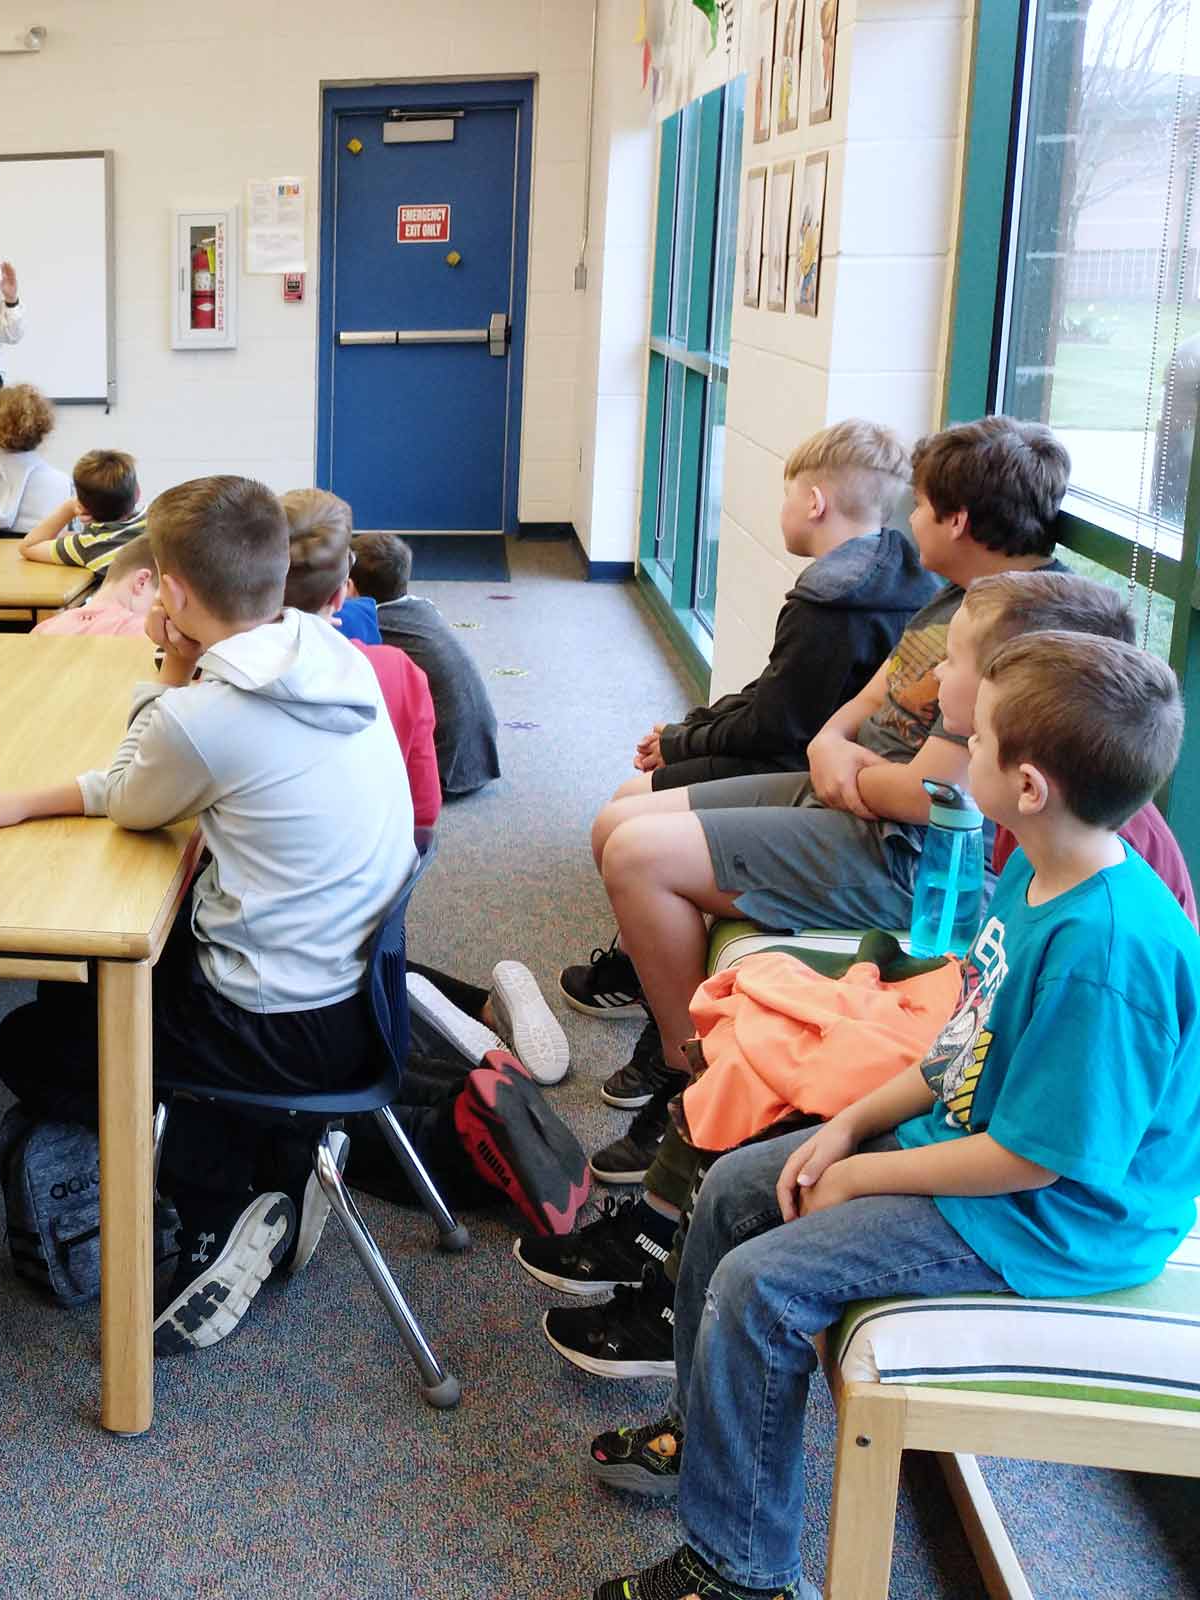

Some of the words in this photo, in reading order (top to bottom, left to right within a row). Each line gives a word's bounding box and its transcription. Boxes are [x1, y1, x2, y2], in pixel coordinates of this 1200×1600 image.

[401, 207, 447, 222] EMERGENCY
[405, 223, 421, 237] EXIT
[422, 223, 442, 237] ONLY
[634, 1232, 671, 1262] PUMA
